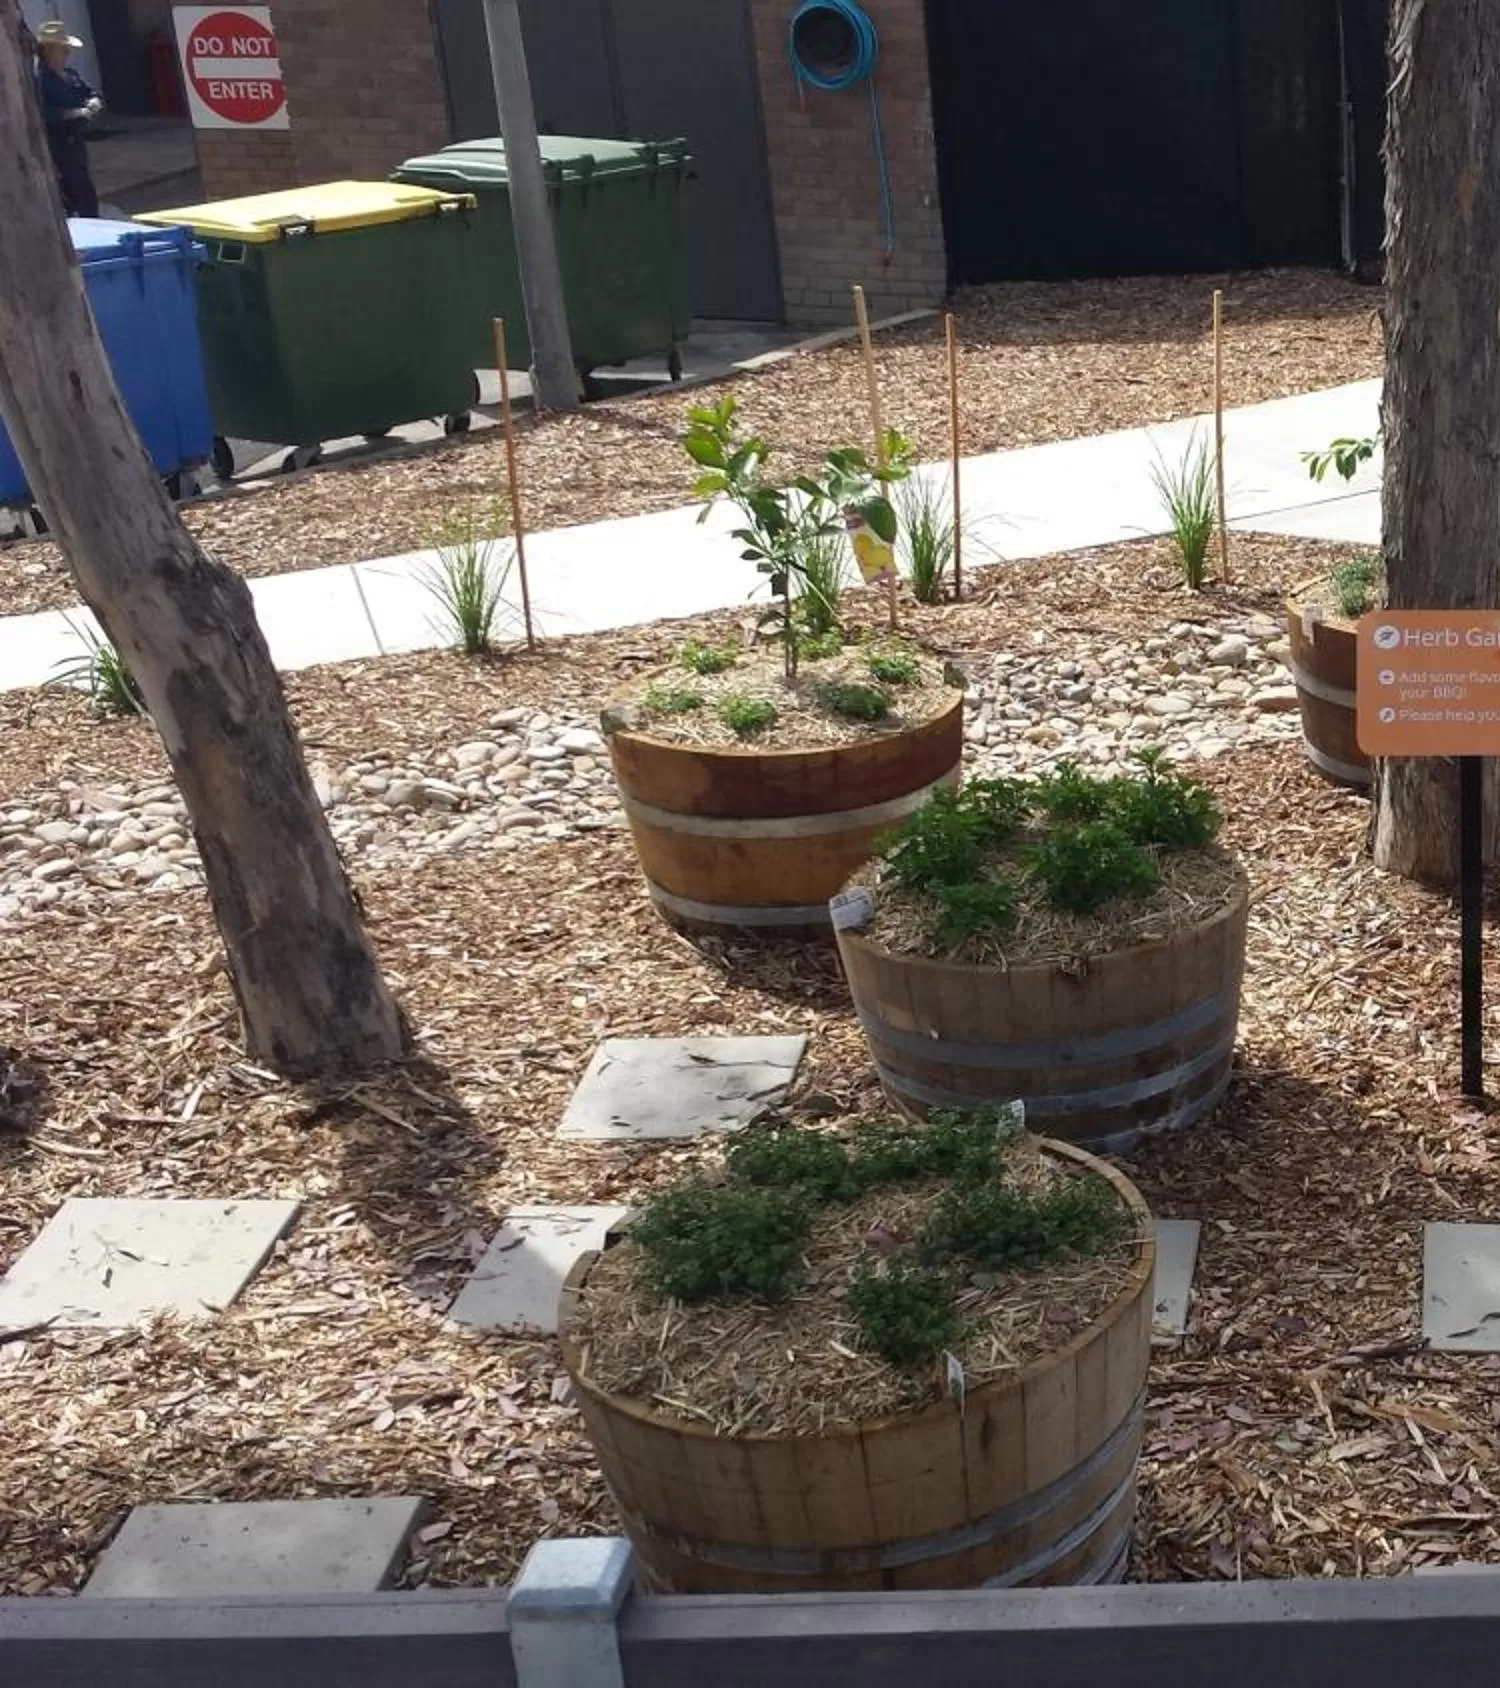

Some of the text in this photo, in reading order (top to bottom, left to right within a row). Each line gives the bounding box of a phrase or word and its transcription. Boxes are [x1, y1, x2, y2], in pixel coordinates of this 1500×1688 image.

[193, 37, 272, 56] DO NOT
[208, 81, 274, 100] ENTER
[1403, 627, 1459, 647] Herb
[1400, 671, 1427, 683] Add
[1429, 673, 1466, 683] some
[1400, 685, 1468, 700] your BBQ!
[1400, 708, 1444, 720] Please
[1446, 708, 1475, 723] help
